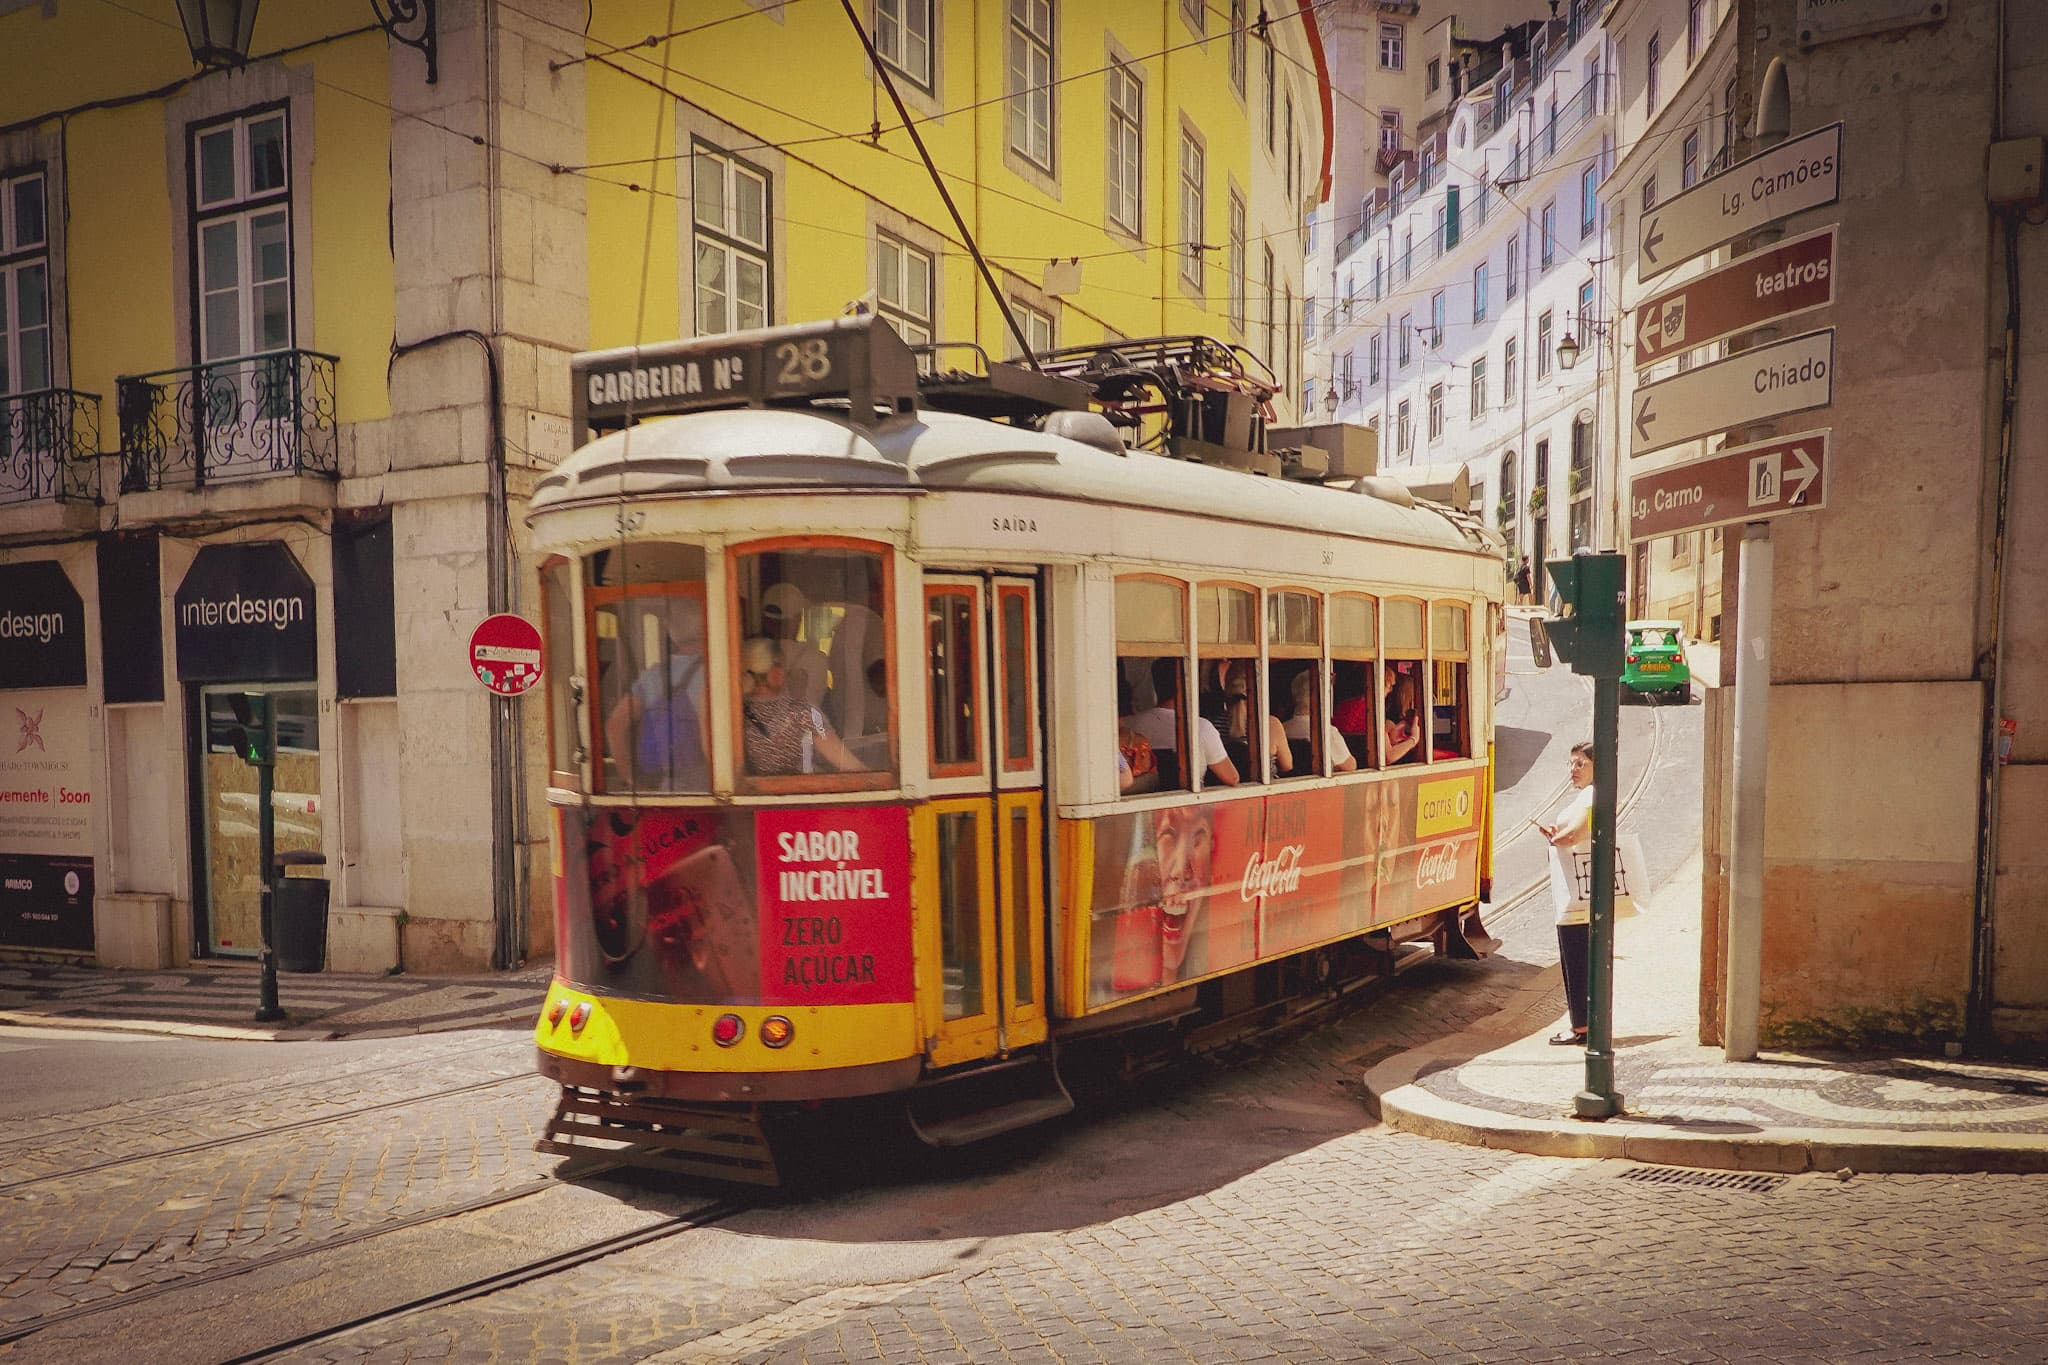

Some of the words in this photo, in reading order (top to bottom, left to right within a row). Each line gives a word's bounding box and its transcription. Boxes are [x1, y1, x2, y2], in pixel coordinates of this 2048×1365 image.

[1721, 192, 1745, 217] Lg.
[1751, 155, 1834, 202] Camões
[1755, 258, 1829, 299] teatros
[588, 361, 702, 406] CARREIRA
[776, 338, 832, 385] 28
[1754, 357, 1827, 394] Chiado
[1631, 494, 1650, 521] Lg.
[1654, 485, 1703, 513] Carmo
[992, 514, 1038, 533] SAÍDA
[0, 610, 63, 643] design
[183, 594, 303, 630] interdesign
[59, 787, 91, 804] Soon
[777, 830, 860, 863] SABOR
[779, 861, 889, 902] INCRÍVEL
[782, 915, 842, 946] ZERO
[782, 947, 876, 993] AÇÚCAR
